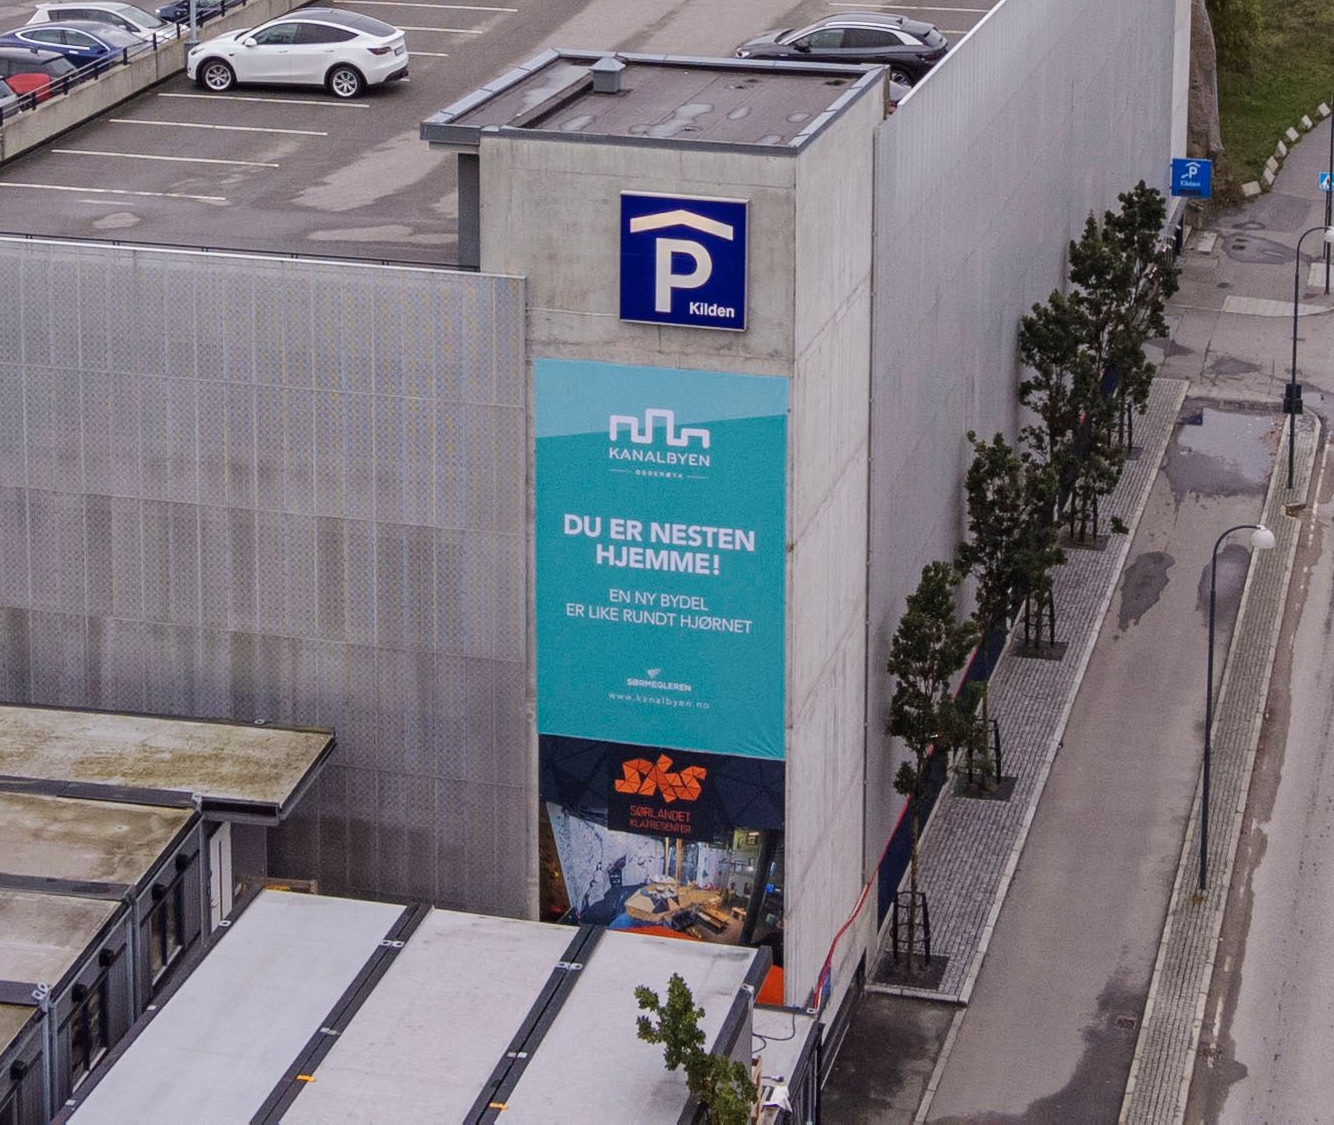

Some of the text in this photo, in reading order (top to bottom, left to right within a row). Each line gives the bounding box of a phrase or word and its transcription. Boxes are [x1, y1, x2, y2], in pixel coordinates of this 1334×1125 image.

[655, 238, 713, 313] P
[689, 302, 735, 318] Kilden
[609, 447, 710, 467] KANALBYEN
[564, 514, 755, 552] DU ER NESTEN
[596, 547, 720, 576] HJEMME!
[609, 588, 709, 611] EN NY BYDEL
[566, 603, 753, 634] ER LIKE RUNDT HJØRNET
[626, 678, 691, 691] SØRMEGLEREN
[607, 692, 710, 709] www.kanalbyen.no
[630, 805, 691, 822] SØRLANDET
